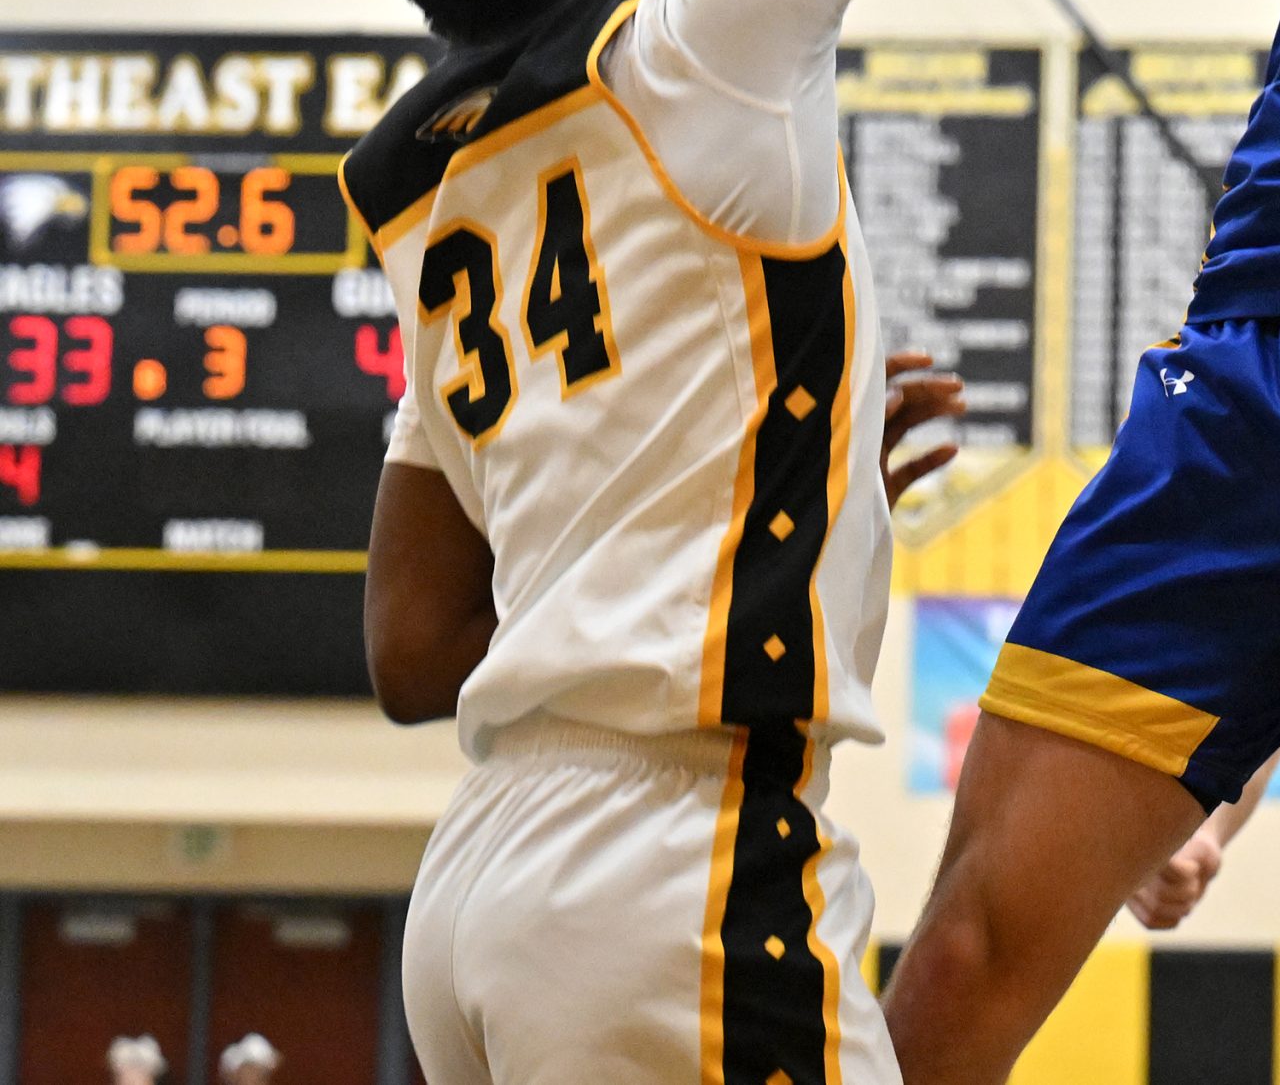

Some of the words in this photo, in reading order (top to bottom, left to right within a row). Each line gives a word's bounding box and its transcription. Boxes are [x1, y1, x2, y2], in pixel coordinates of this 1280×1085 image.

[110, 165, 296, 255] 52.6
[415, 153, 623, 453] 34
[6, 314, 116, 406] 33
[202, 324, 248, 400] 3
